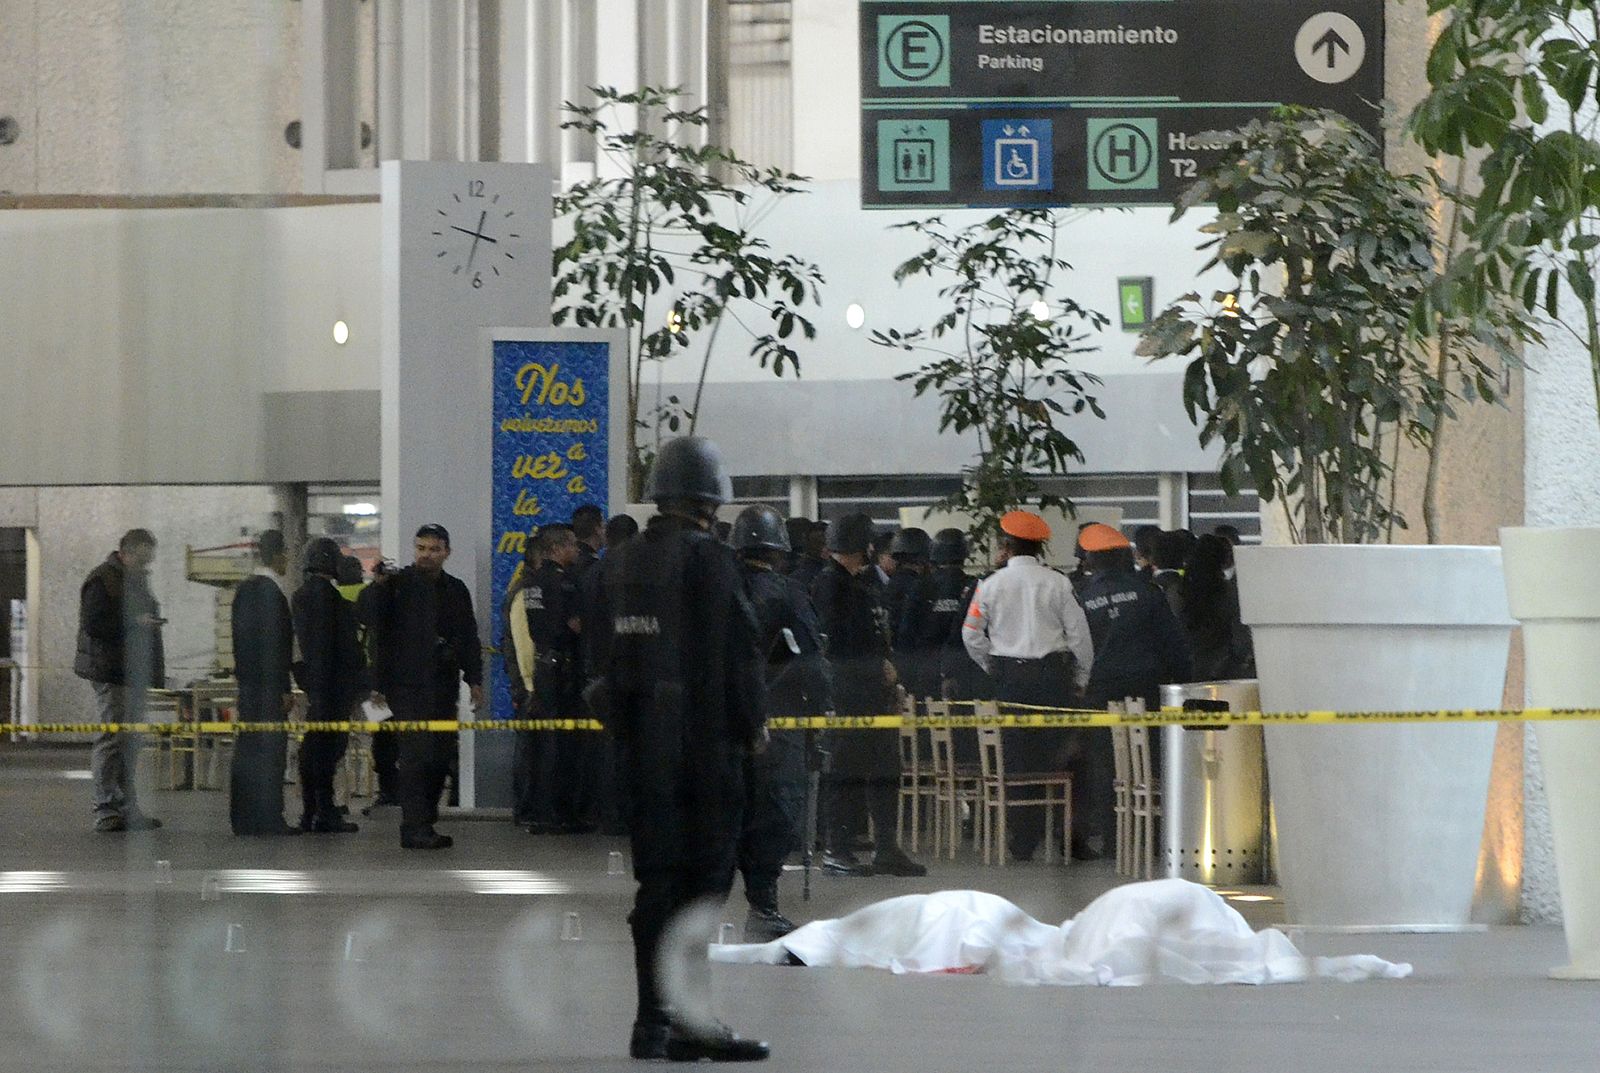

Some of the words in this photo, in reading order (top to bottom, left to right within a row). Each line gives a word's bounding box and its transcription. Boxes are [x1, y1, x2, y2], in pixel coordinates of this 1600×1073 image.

[978, 24, 1179, 44] Estacionamiento
[902, 31, 929, 69] E
[978, 54, 1044, 71] Parking
[1109, 134, 1136, 172] H
[1169, 158, 1198, 177] T2
[468, 180, 485, 198] 12
[472, 271, 483, 289] 6
[515, 362, 585, 406] Nos
[566, 442, 588, 461] a
[566, 475, 588, 494] a
[512, 488, 542, 515] la
